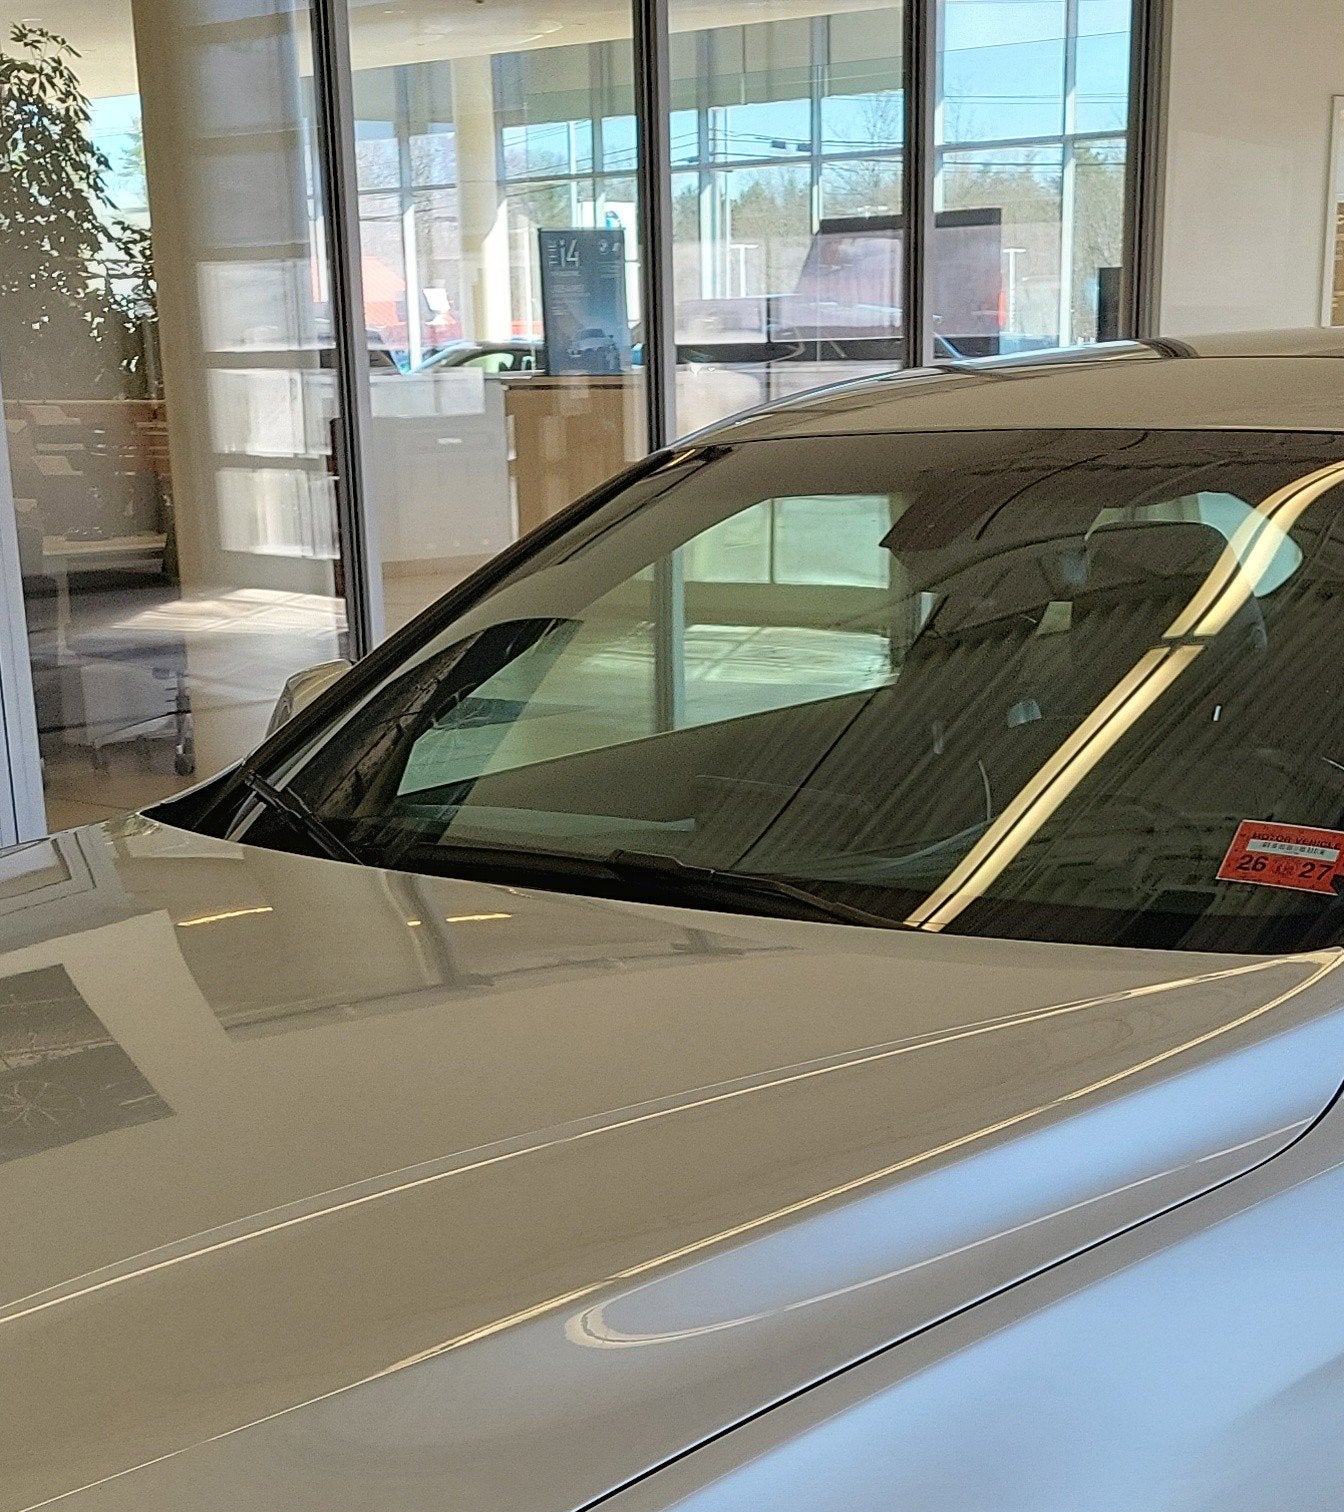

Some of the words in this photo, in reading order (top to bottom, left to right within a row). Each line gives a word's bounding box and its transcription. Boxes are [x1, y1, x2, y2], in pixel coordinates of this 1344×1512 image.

[1252, 832, 1291, 843] MOTOR
[1295, 837, 1342, 849] VEHICLE
[1236, 854, 1269, 872] 26
[1298, 861, 1335, 881] 27
